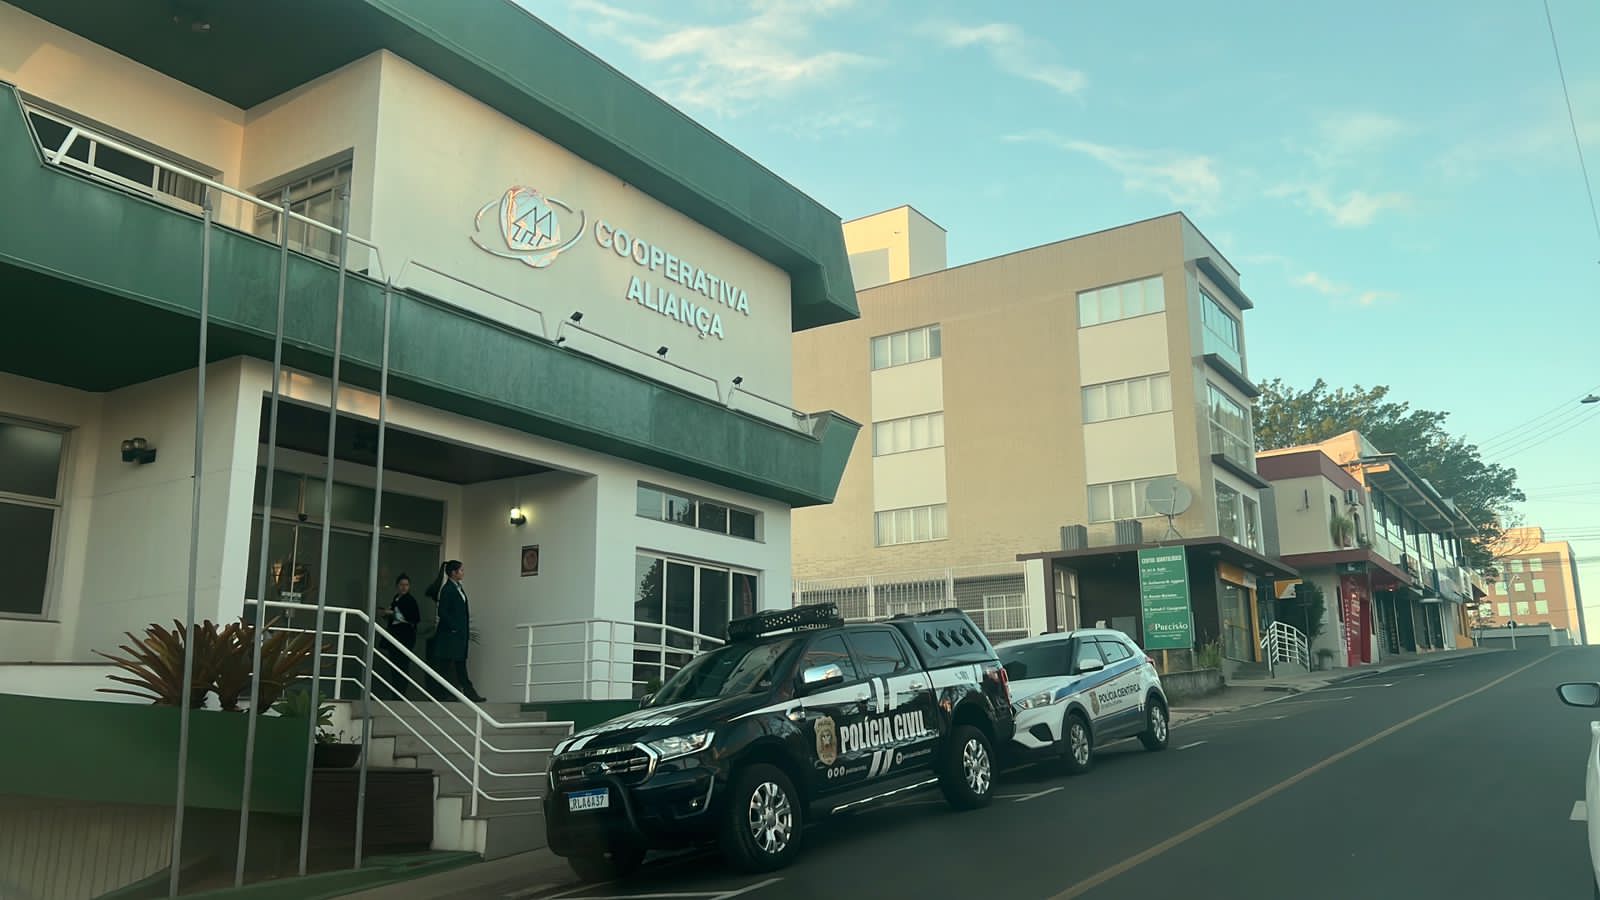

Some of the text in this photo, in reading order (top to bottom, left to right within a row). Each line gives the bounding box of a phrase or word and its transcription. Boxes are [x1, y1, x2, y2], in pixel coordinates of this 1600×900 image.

[594, 218, 750, 316] COOPERATIVA
[625, 275, 724, 340] ALIANÇA
[1098, 683, 1142, 704] POLÍCIA CIENTÍFICA
[840, 710, 927, 754] POLÍCIA CIVIL
